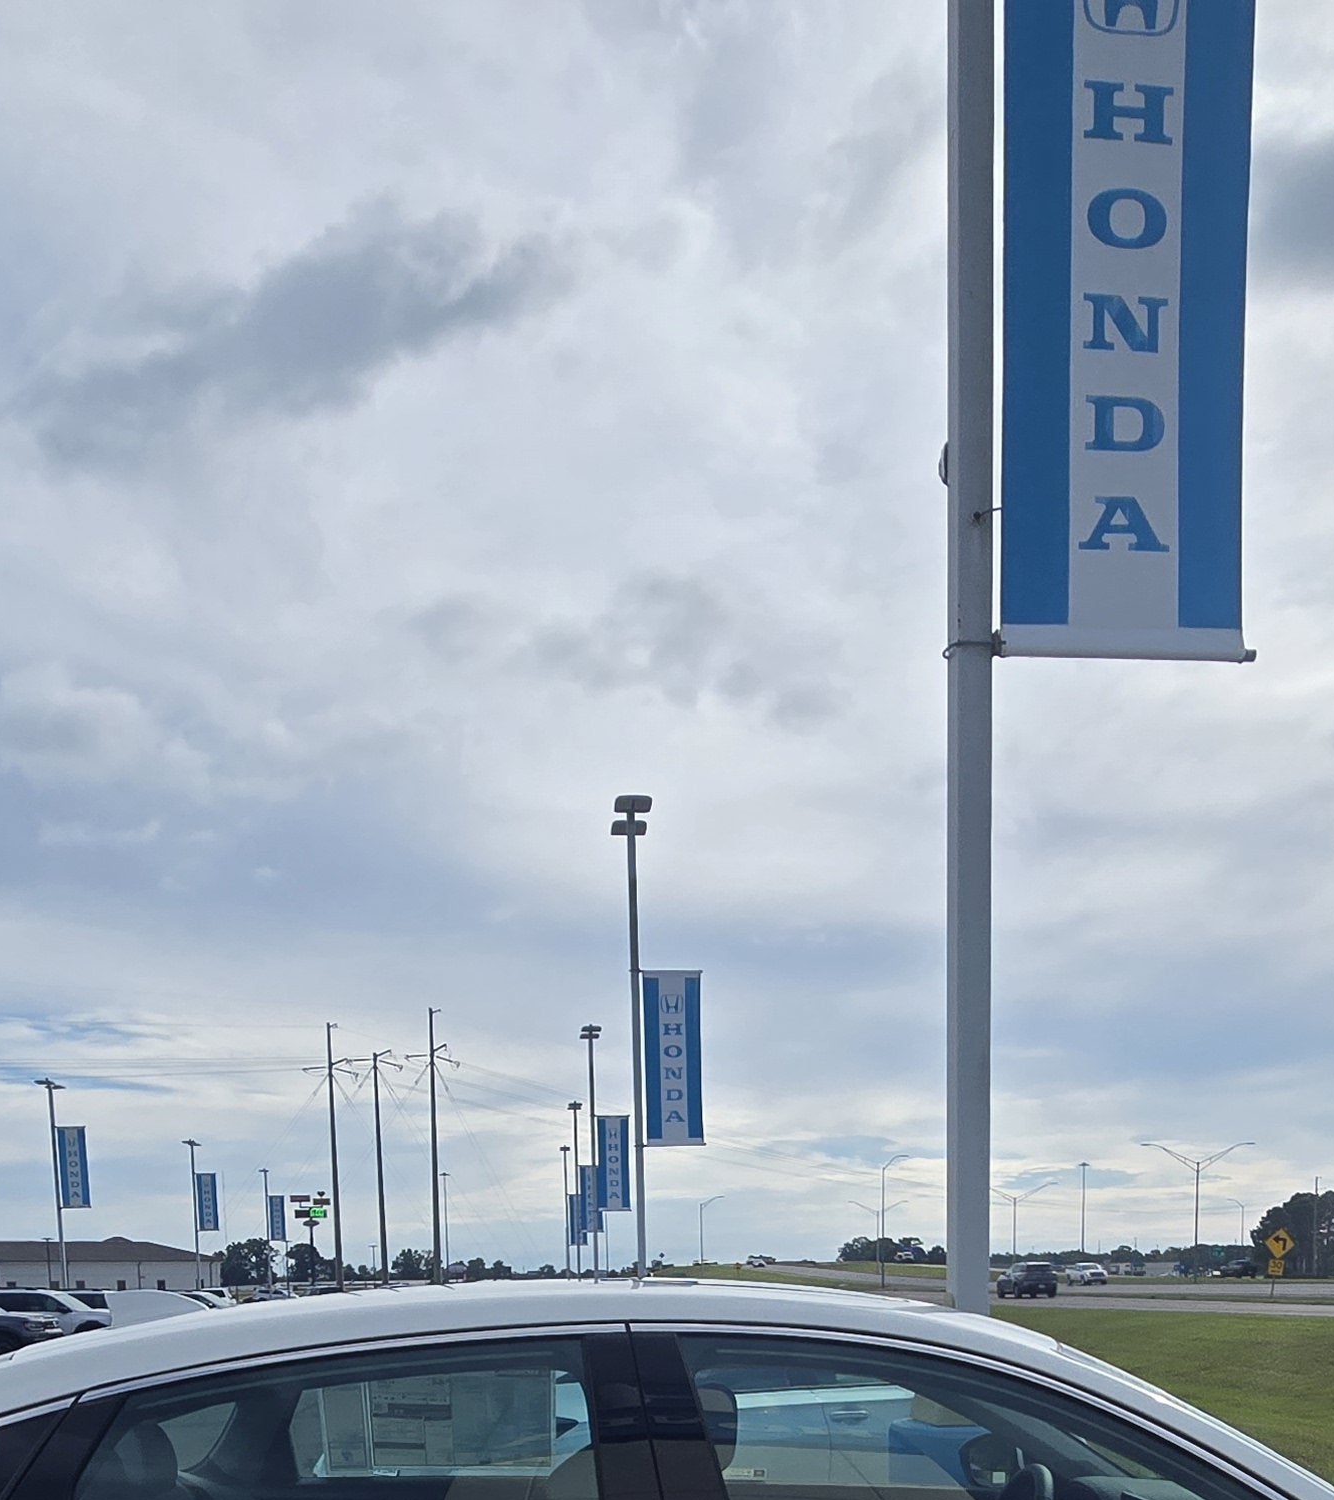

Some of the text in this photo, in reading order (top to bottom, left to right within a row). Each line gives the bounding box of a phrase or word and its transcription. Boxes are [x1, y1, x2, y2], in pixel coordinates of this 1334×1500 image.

[1078, 79, 1174, 554] HONDA
[661, 1022, 685, 1123] HONDA
[68, 1150, 81, 1198] HONDA
[608, 1143, 620, 1199] HONDA
